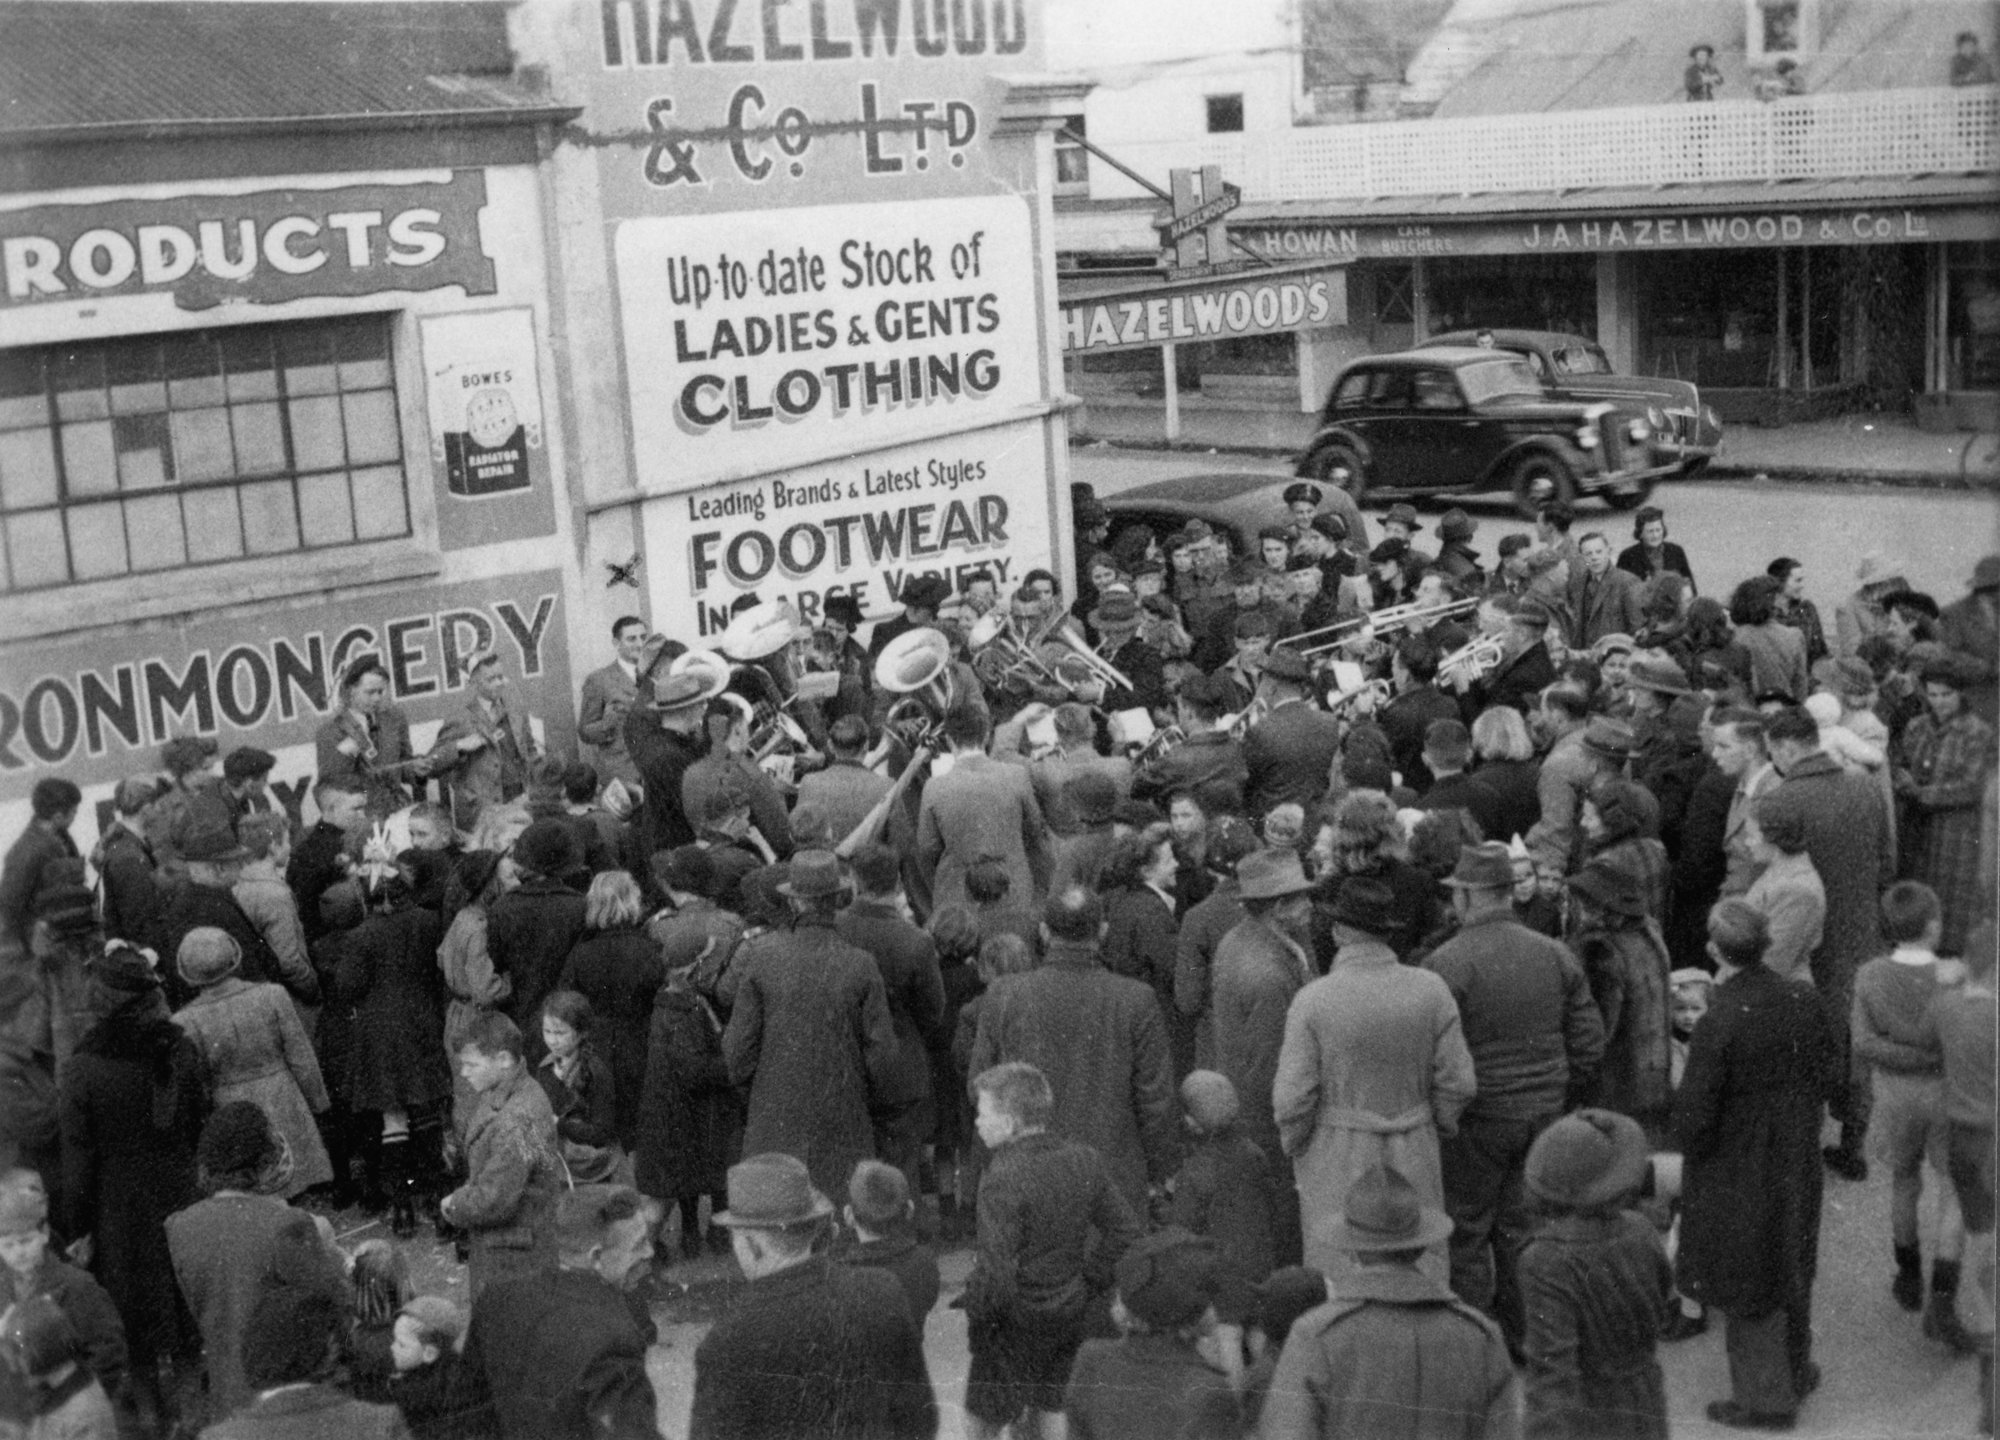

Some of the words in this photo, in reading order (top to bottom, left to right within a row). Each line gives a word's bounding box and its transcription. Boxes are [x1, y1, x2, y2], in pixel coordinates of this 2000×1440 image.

[645, 98, 702, 186] &
[839, 237, 936, 289] Stock
[950, 231, 985, 280] of
[1264, 229, 1358, 254] HOWAN
[1581, 214, 1803, 248] HAZELWOOD
[1820, 219, 1839, 240] &
[673, 309, 838, 364] LADIES
[847, 314, 871, 347] &
[875, 292, 1001, 343] GENTS
[1060, 275, 1330, 350] HAZELWOOD'S
[461, 370, 513, 388] BOWES
[676, 349, 1001, 430] CLOTHING
[688, 486, 766, 522] Leading
[773, 478, 842, 510] Brands
[848, 483, 859, 499] &
[864, 466, 922, 498] Latest
[927, 458, 987, 492] Styles
[689, 495, 1010, 592] FOOTWEAR
[697, 600, 729, 637] IN
